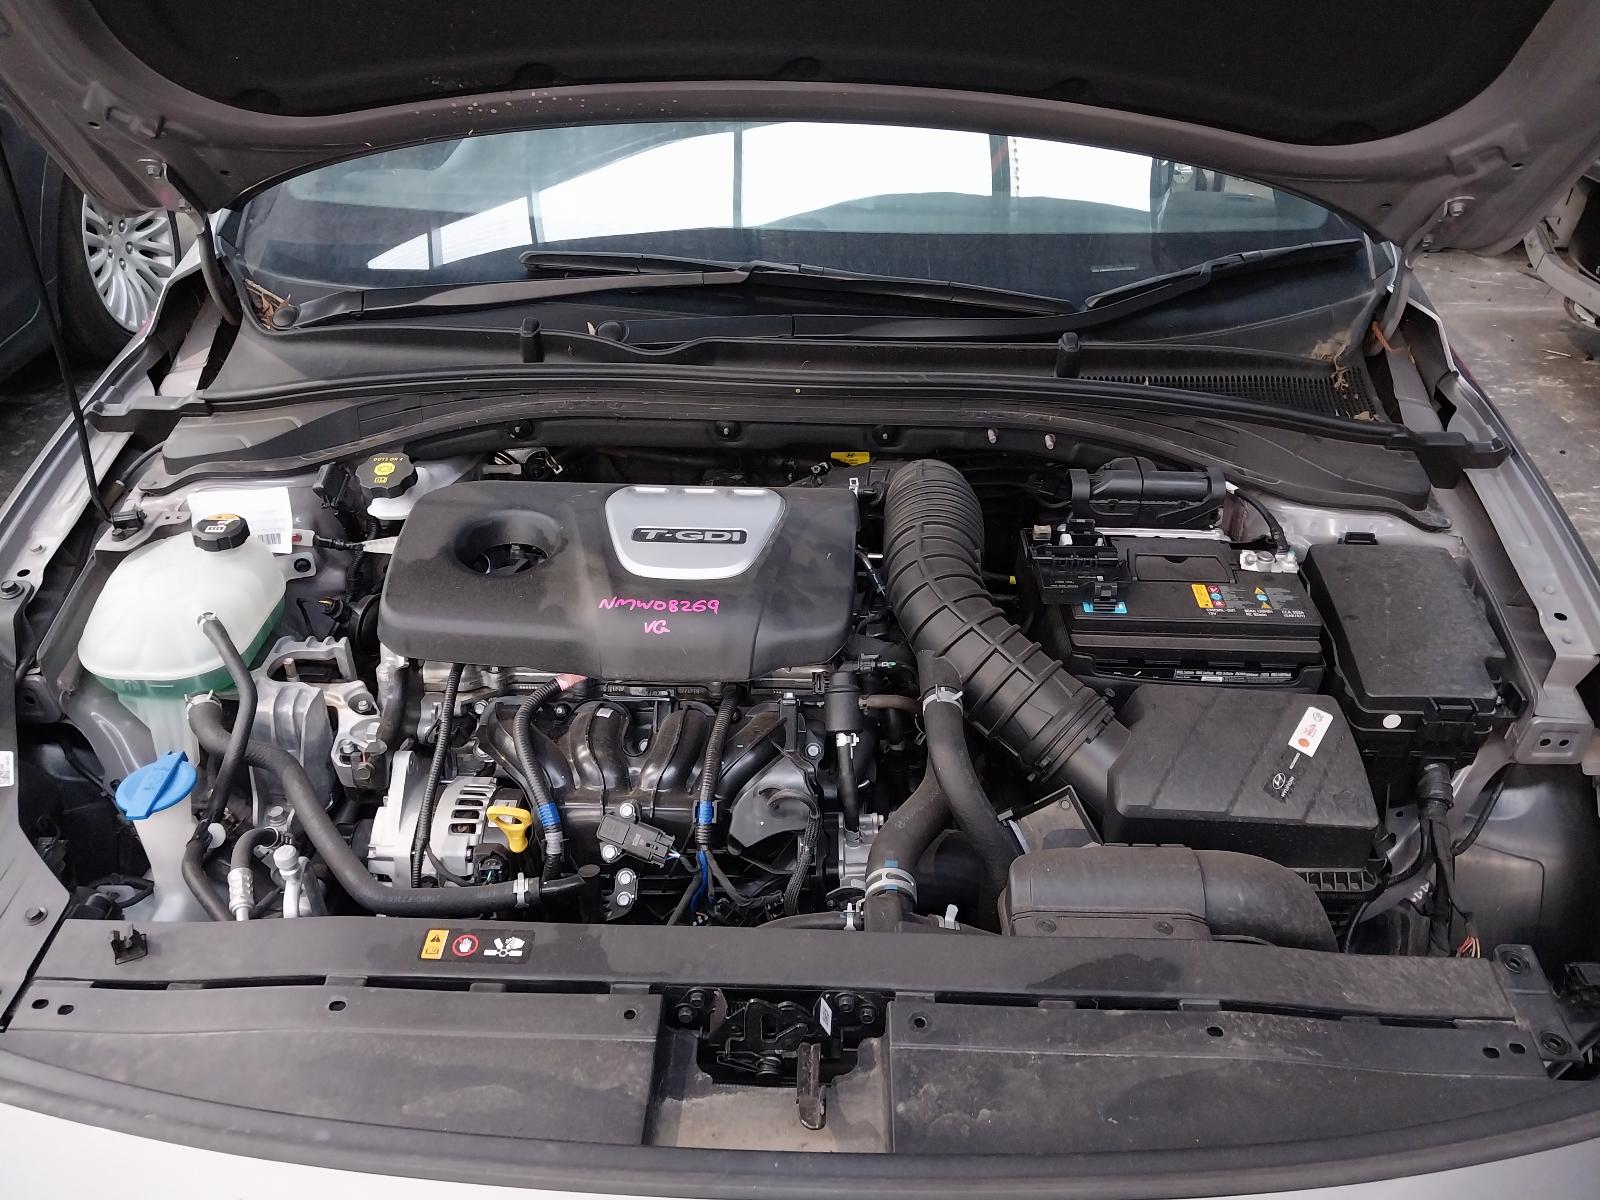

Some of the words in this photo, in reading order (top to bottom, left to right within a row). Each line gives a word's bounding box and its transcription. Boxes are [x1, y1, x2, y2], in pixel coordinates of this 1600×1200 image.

[640, 529, 741, 542] T-GDI
[598, 596, 721, 614] NMW08269
[643, 618, 671, 634] VG
